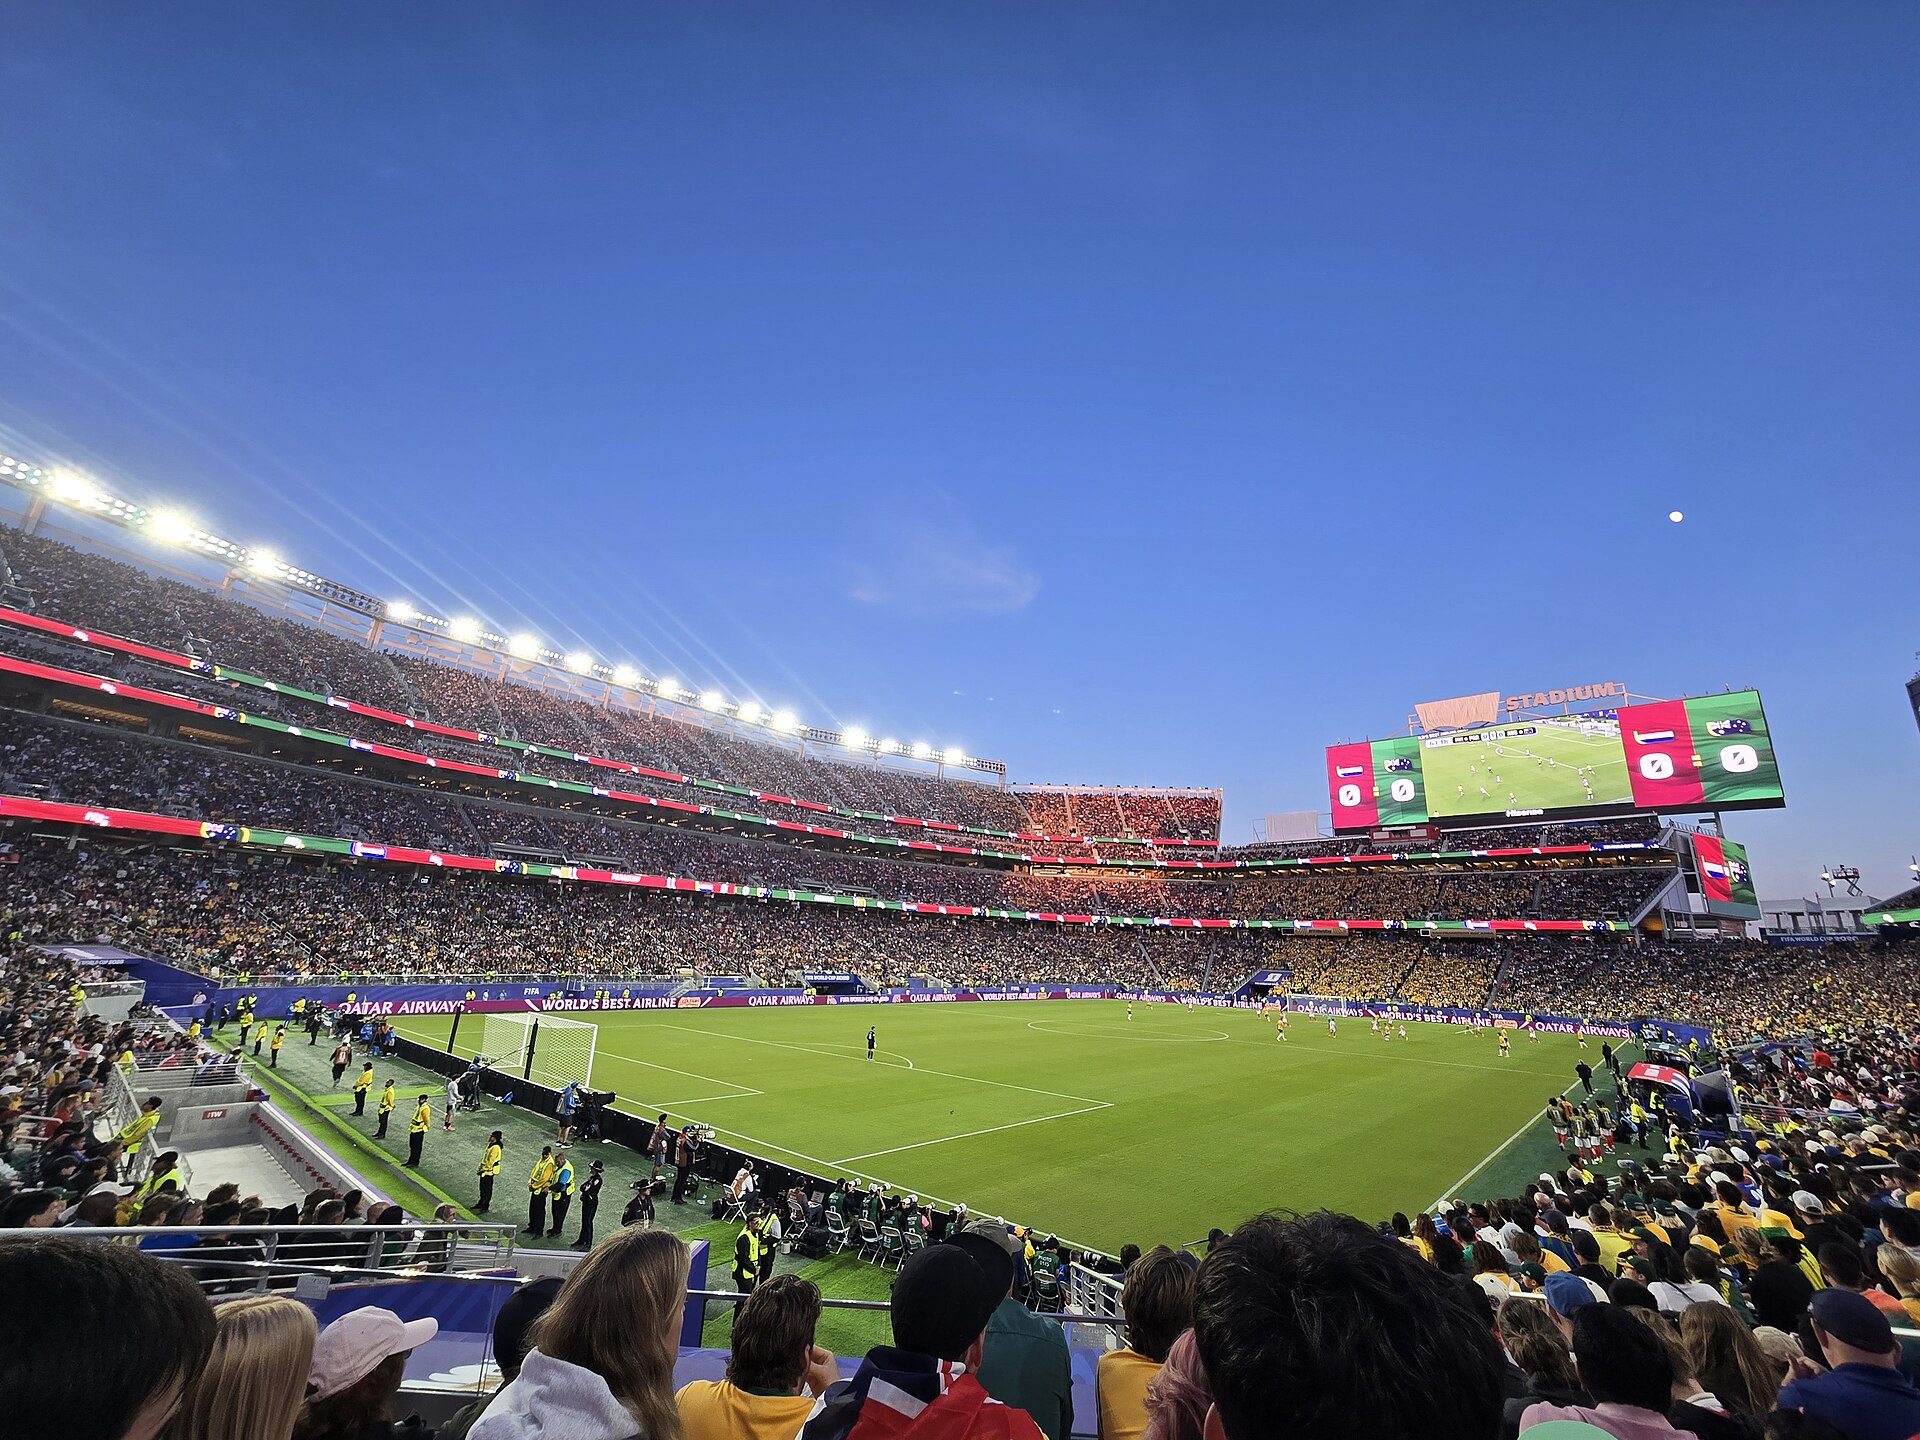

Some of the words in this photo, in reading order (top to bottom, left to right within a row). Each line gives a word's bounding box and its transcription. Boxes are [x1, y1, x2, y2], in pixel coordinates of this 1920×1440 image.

[1506, 682, 1615, 711] STADIUM
[1505, 808, 1544, 818] Hisense
[748, 996, 778, 1006] QATAR
[780, 995, 815, 1005] AIRWAYS
[910, 994, 931, 1003] QATAR
[932, 993, 957, 1001] AIRWAYS
[983, 993, 1006, 1001] WORLD'S
[1116, 993, 1138, 1001] QATAR
[1139, 994, 1167, 1003] AIRWAYS
[1180, 996, 1212, 1006] WORLD'S
[1213, 999, 1232, 1007] BEST
[1233, 1000, 1263, 1009] AIRLINE
[338, 1001, 394, 1014] QATAR
[398, 1001, 466, 1014] AIRWAYS
[542, 999, 599, 1010] WORLD'S
[602, 999, 630, 1009] BEST
[633, 997, 677, 1008] AIRLINE
[1379, 1010, 1422, 1022] WORLD'S
[1424, 1014, 1449, 1023] BEST
[1535, 1021, 1576, 1034] QATAR
[1579, 1025, 1630, 1039] AIRWAYS
[207, 1111, 223, 1119] ITW
